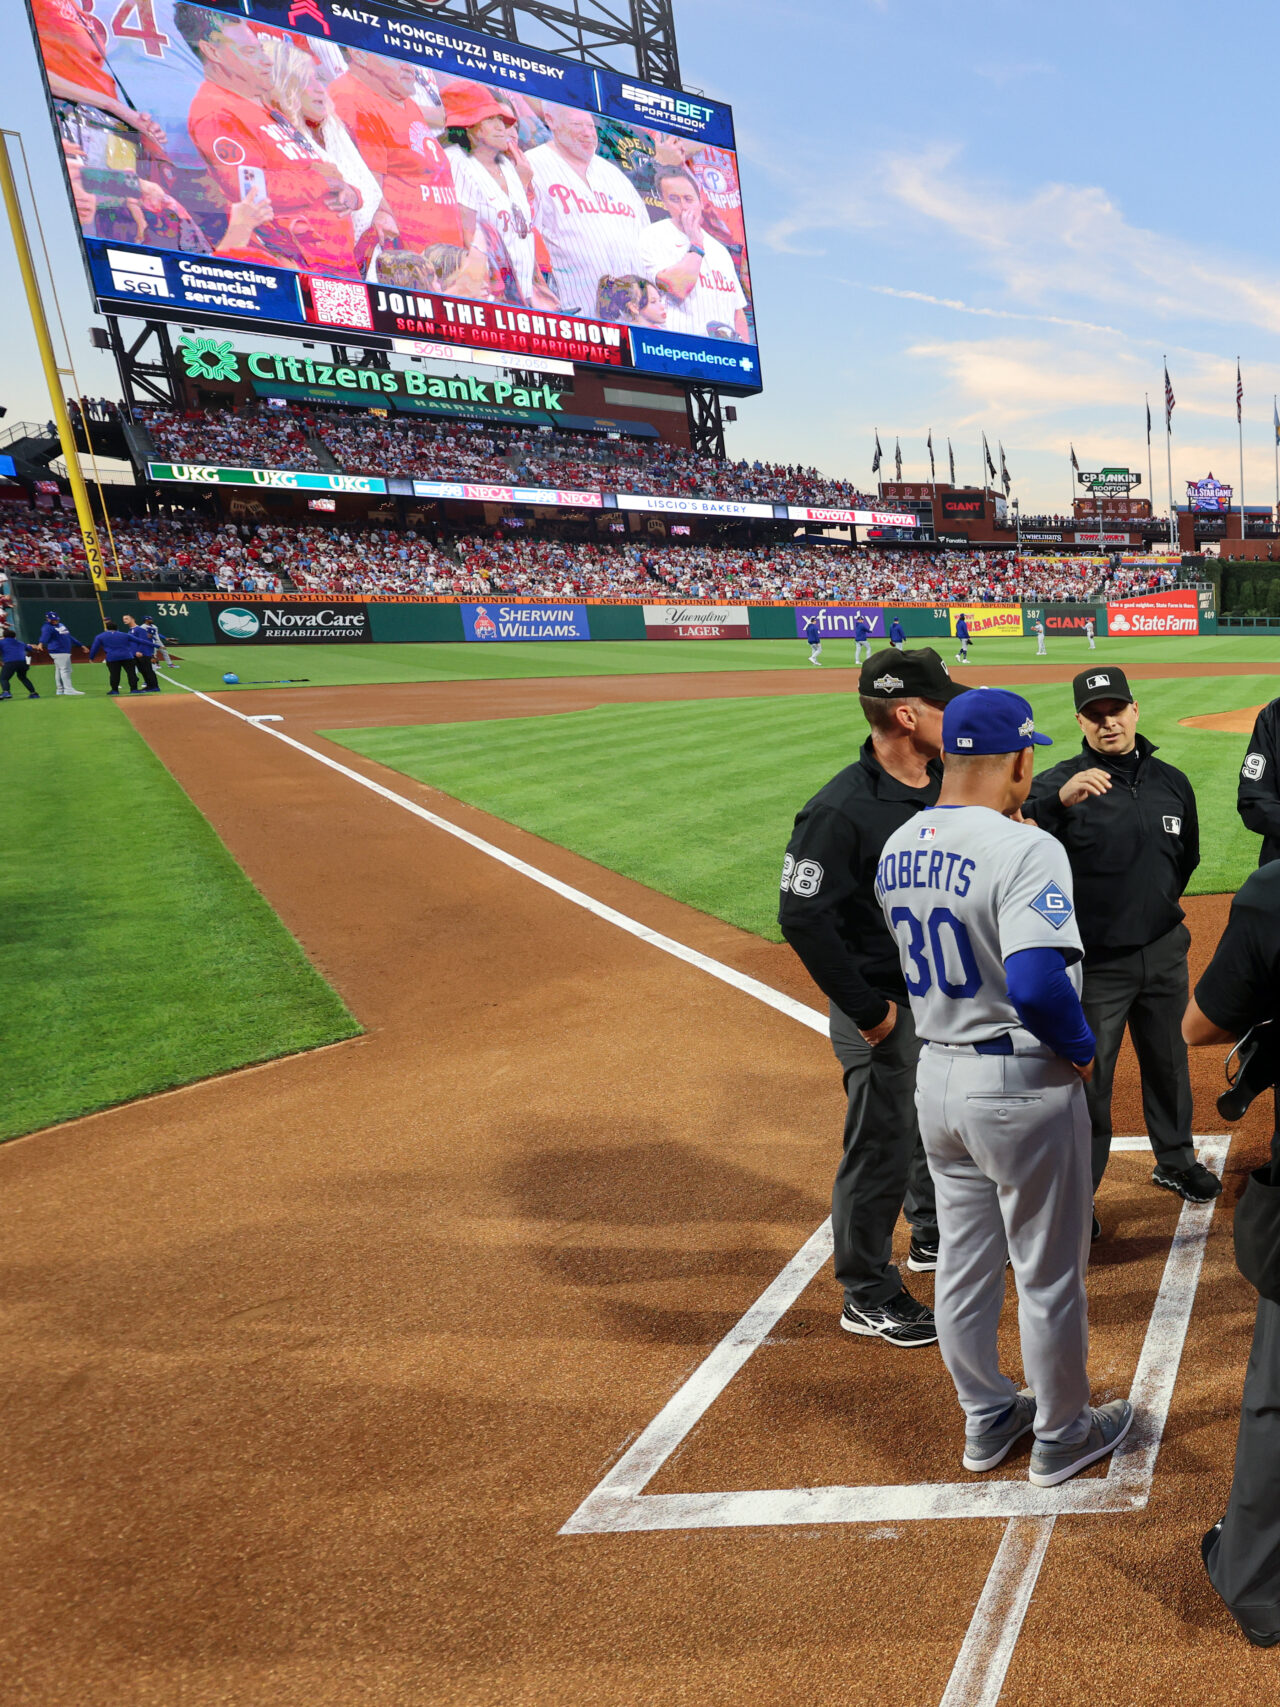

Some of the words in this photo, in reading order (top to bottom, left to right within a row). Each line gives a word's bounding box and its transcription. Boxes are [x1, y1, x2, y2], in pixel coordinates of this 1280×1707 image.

[331, 4, 381, 27] SALTZ
[387, 20, 487, 58] MONGELUZZI
[492, 50, 565, 80] BENDESKY
[384, 34, 443, 59] INJURY
[457, 55, 526, 82] LAWYERS
[621, 83, 674, 112] ESPN
[676, 99, 714, 122] BET
[634, 103, 706, 129] SPORTSBOOK
[549, 184, 636, 218] Phillies
[178, 260, 278, 288] Connecting
[181, 274, 257, 296] financial
[184, 291, 260, 310] services.
[377, 291, 434, 318] JOIN
[443, 301, 486, 327] THE
[494, 308, 621, 347] LIGHTSHOW
[396, 318, 435, 335] SCAN
[440, 323, 465, 338] THE
[472, 328, 506, 345] CODE
[511, 334, 527, 348] TO
[533, 338, 611, 359] PARTICIPATE
[642, 343, 737, 367] Independence
[248, 352, 398, 393] Citizens
[404, 370, 489, 401] Bank
[493, 380, 563, 410] Park
[414, 399, 475, 412] HARRY
[171, 465, 219, 482] UKG
[252, 471, 298, 487] UKG
[328, 476, 370, 491] UKG
[467, 486, 512, 500] NECA
[559, 493, 601, 505] NECA
[1200, 488, 1215, 496] STAR
[1216, 488, 1232, 496] GAME
[647, 500, 698, 511] LISCIO'S
[702, 503, 747, 513] BAKERY
[945, 502, 981, 511] GIANT
[810, 509, 852, 521] TOYOTA
[875, 514, 913, 525] TOYOTA
[182, 593, 263, 601] ASPLUNDH
[280, 594, 354, 602] ASPLUNDH
[157, 603, 189, 616] 334
[499, 607, 574, 622] SHERWIN
[665, 607, 730, 624] Yuengling
[933, 609, 947, 618] 374
[1027, 610, 1040, 618] 387
[1204, 611, 1215, 619] 409
[262, 610, 365, 626] NovaCare
[1131, 614, 1166, 630] State
[1166, 615, 1197, 630] Farm
[265, 629, 363, 637] REHABILITATION
[678, 626, 720, 636] LAGER
[1242, 752, 1266, 782] 9
[876, 850, 976, 898] ROBERTS
[1046, 893, 1064, 909] G
[891, 907, 984, 1000] 30
